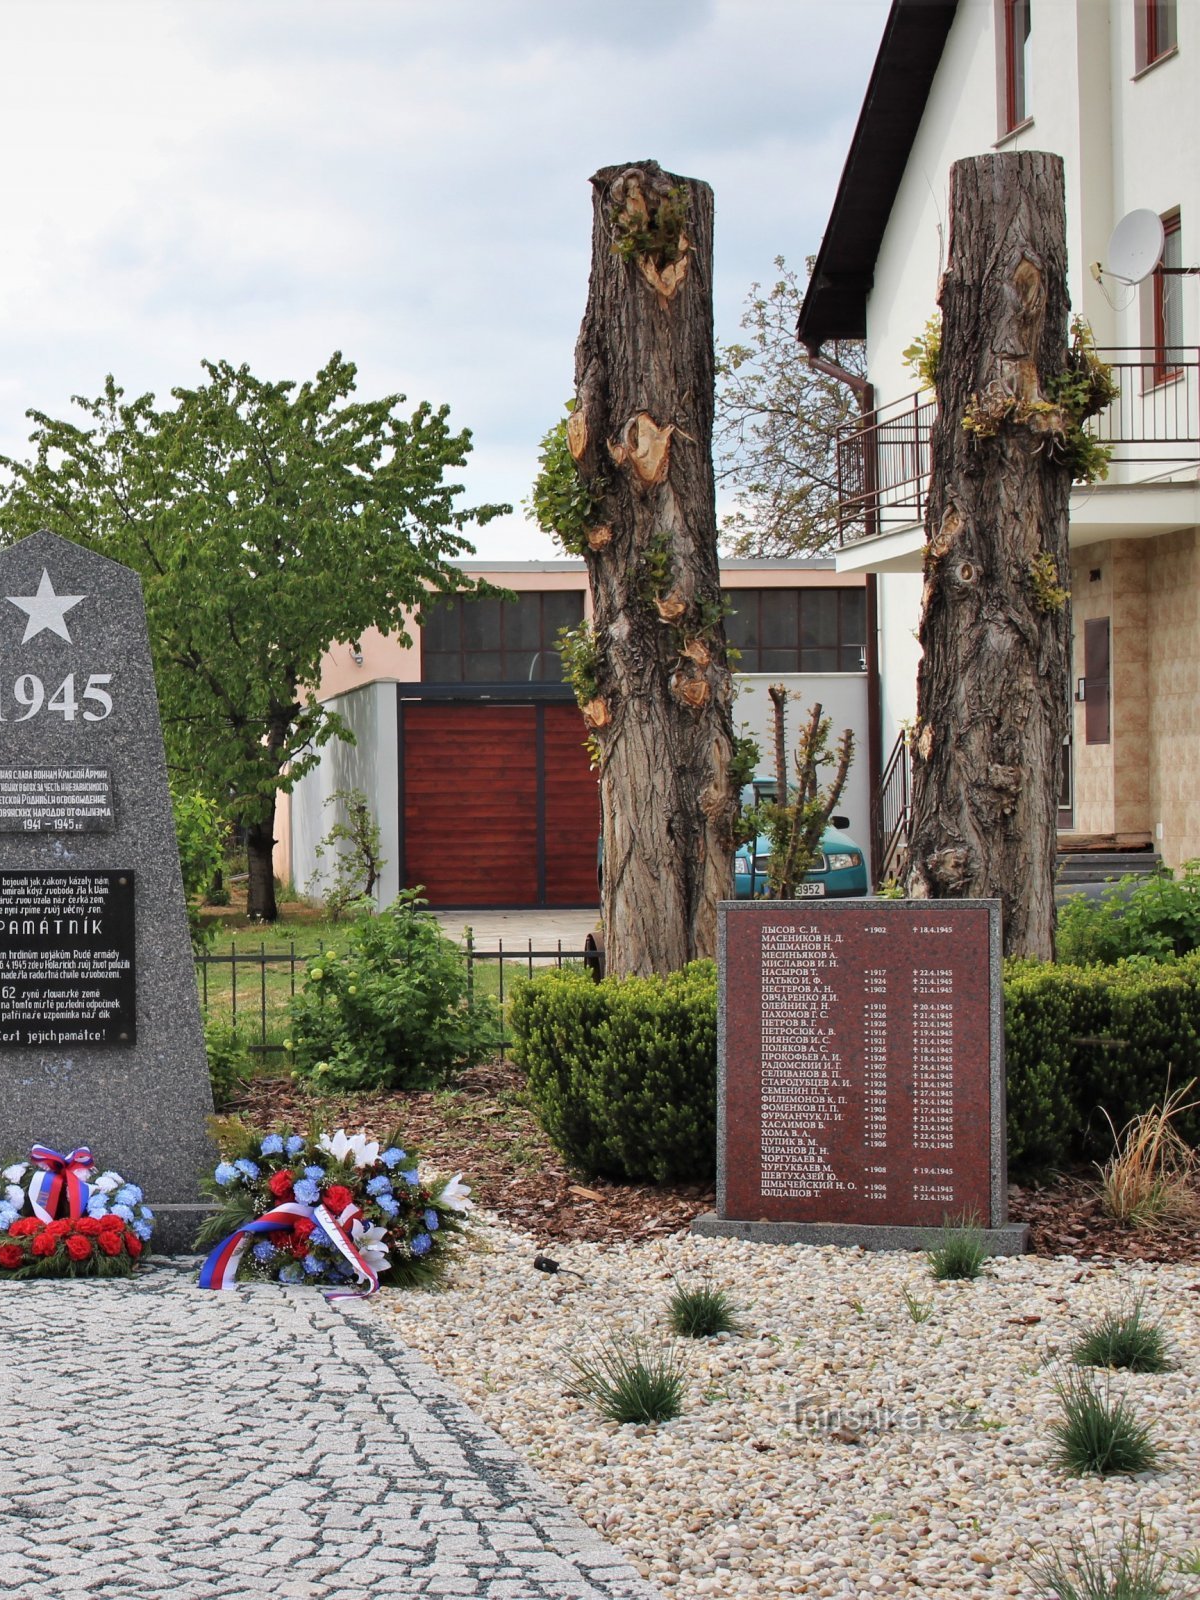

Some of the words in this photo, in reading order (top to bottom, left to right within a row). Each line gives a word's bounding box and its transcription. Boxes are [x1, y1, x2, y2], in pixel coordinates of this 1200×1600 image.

[23, 819, 40, 829] 1941
[54, 819, 74, 829] 1945
[3, 877, 28, 887] bojovali
[30, 877, 41, 887] jak
[45, 886, 73, 894] svoboda
[89, 886, 93, 894] k
[34, 896, 50, 904] vzala
[94, 950, 119, 962] armády
[28, 961, 38, 969] zde
[2, 986, 16, 998] 62
[12, 1000, 32, 1009] tomto
[86, 999, 120, 1011] odpočinek
[762, 1001, 808, 1010] ОЛЕЙНИК
[27, 1030, 57, 1044] jejich
[761, 1104, 815, 1112] ФОМЕНКОВ
[761, 1146, 807, 1154] ЧИРАНОВ
[761, 1189, 812, 1197] ЮЛДАШОВ
